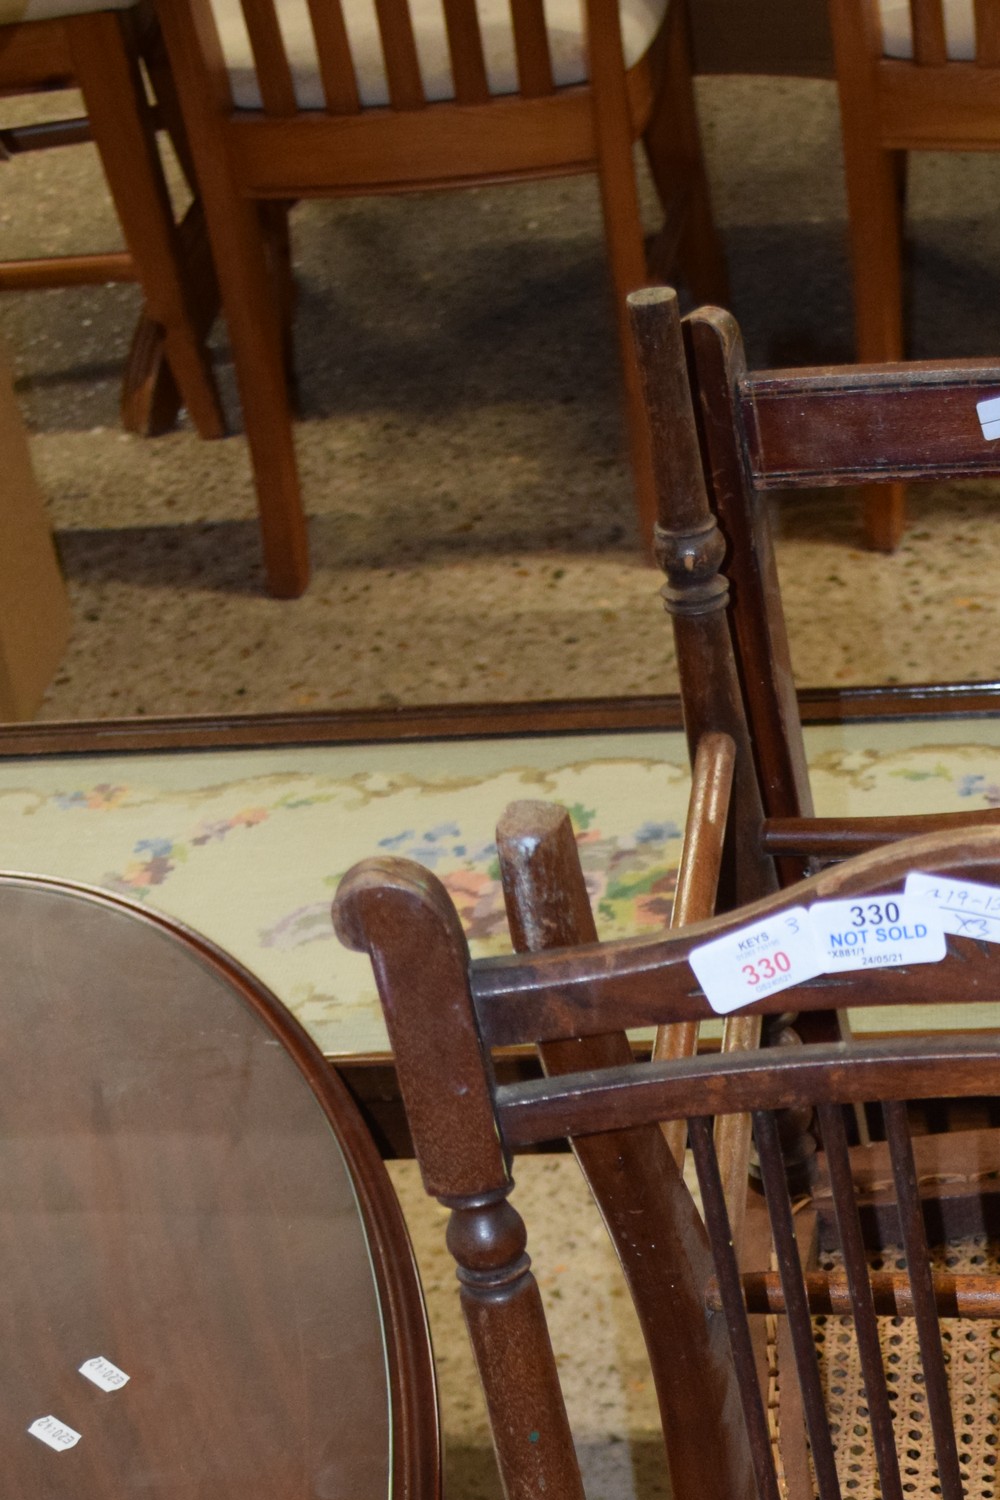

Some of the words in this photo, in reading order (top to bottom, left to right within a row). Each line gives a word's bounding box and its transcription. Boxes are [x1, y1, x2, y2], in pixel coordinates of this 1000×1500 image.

[850, 902, 899, 926] 330
[738, 932, 769, 950] KEYS
[830, 929, 868, 947] NOT
[875, 924, 927, 942] SOLD
[742, 952, 791, 986] 330
[862, 953, 903, 965] 24/05/21
